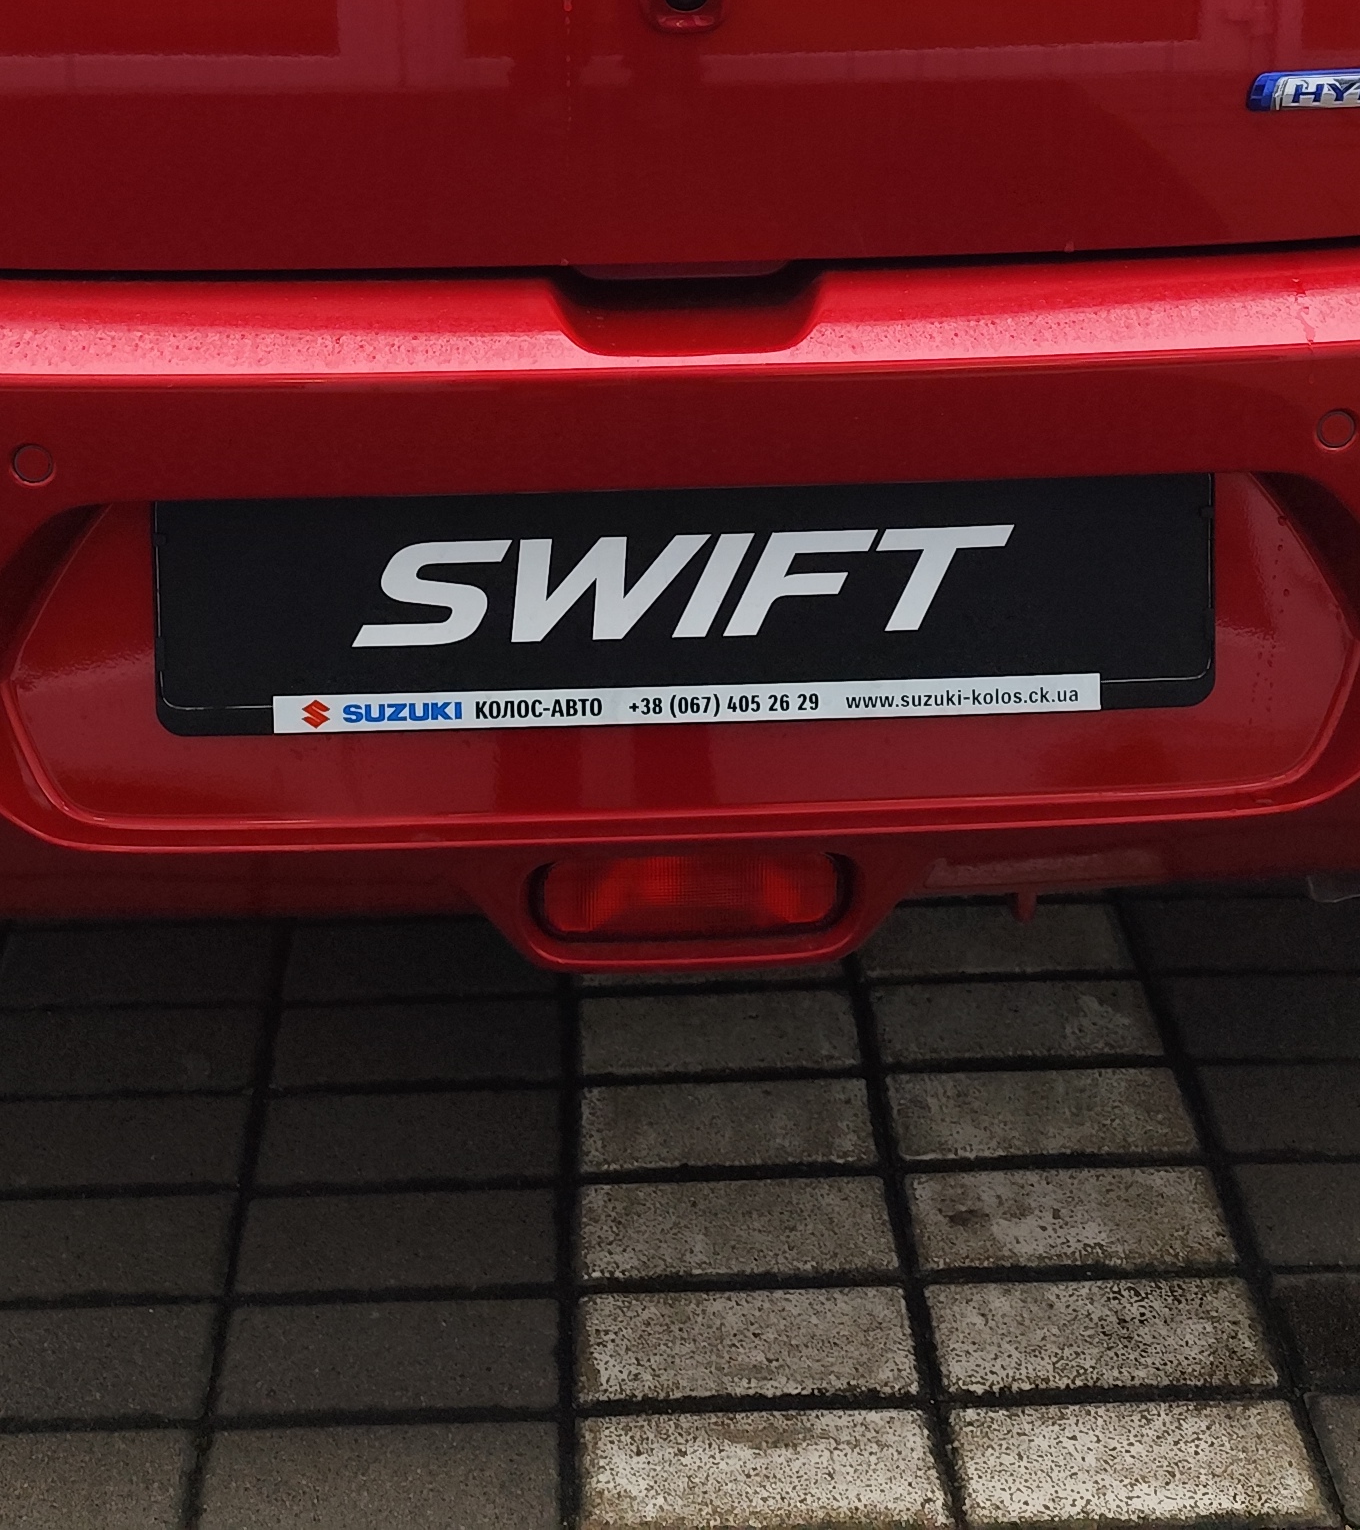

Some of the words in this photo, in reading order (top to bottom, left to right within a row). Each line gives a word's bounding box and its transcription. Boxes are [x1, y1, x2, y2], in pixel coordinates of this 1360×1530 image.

[352, 524, 1015, 648] SWIFT
[342, 701, 463, 723] SUZUKI
[474, 697, 603, 720] КОЛОС-АВТО
[628, 696, 663, 716] +38
[669, 693, 721, 718] (067)
[727, 693, 761, 713] 405
[768, 693, 790, 713] 26
[797, 692, 820, 712] 29
[845, 687, 1079, 710] www.suzuki-kolos.ck.ua
